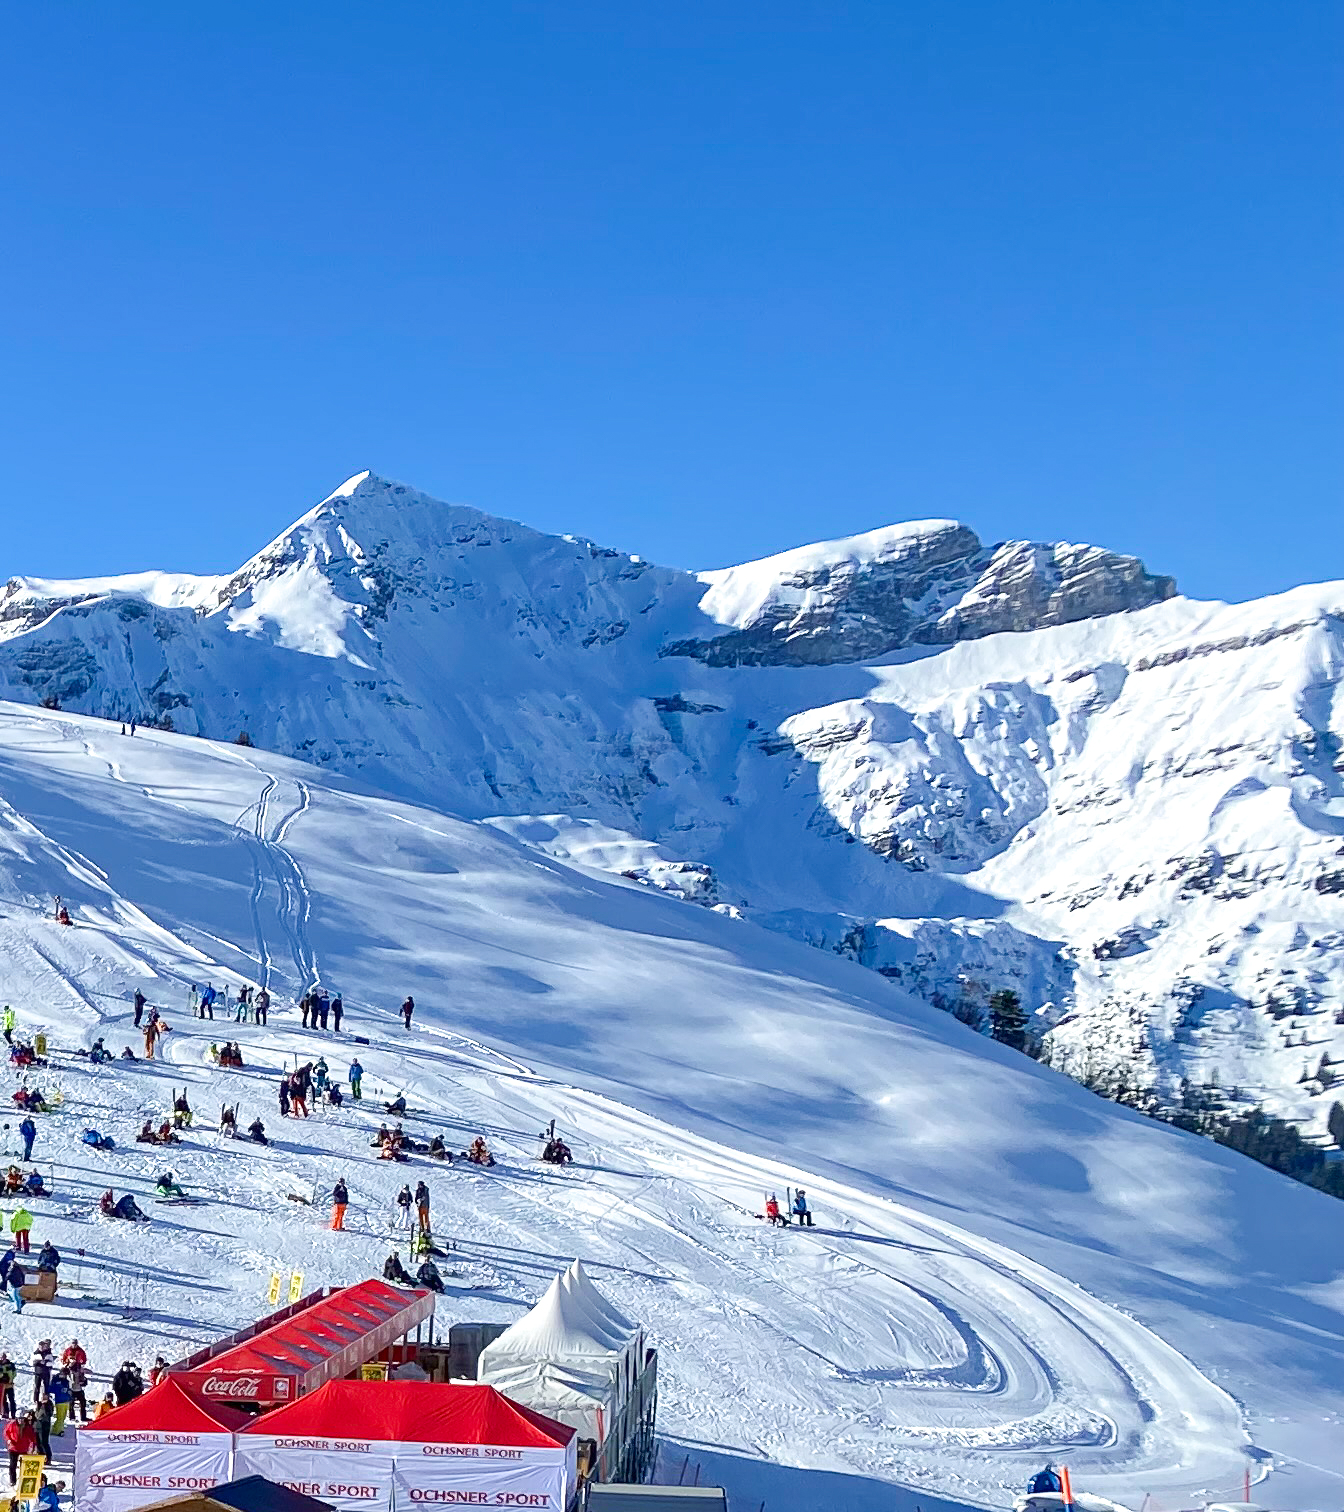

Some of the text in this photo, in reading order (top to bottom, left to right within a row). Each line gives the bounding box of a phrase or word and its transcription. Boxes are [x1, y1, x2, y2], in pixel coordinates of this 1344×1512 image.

[107, 1433, 200, 1445] OCHSNER SPORT
[274, 1438, 372, 1452] OCHSNER SPORT
[422, 1445, 524, 1460] OCHSNER SPORT
[89, 1474, 219, 1489] OCHSNER SPORT
[328, 1484, 381, 1498] SPORT
[410, 1488, 551, 1506] OCHSNER SPORT
